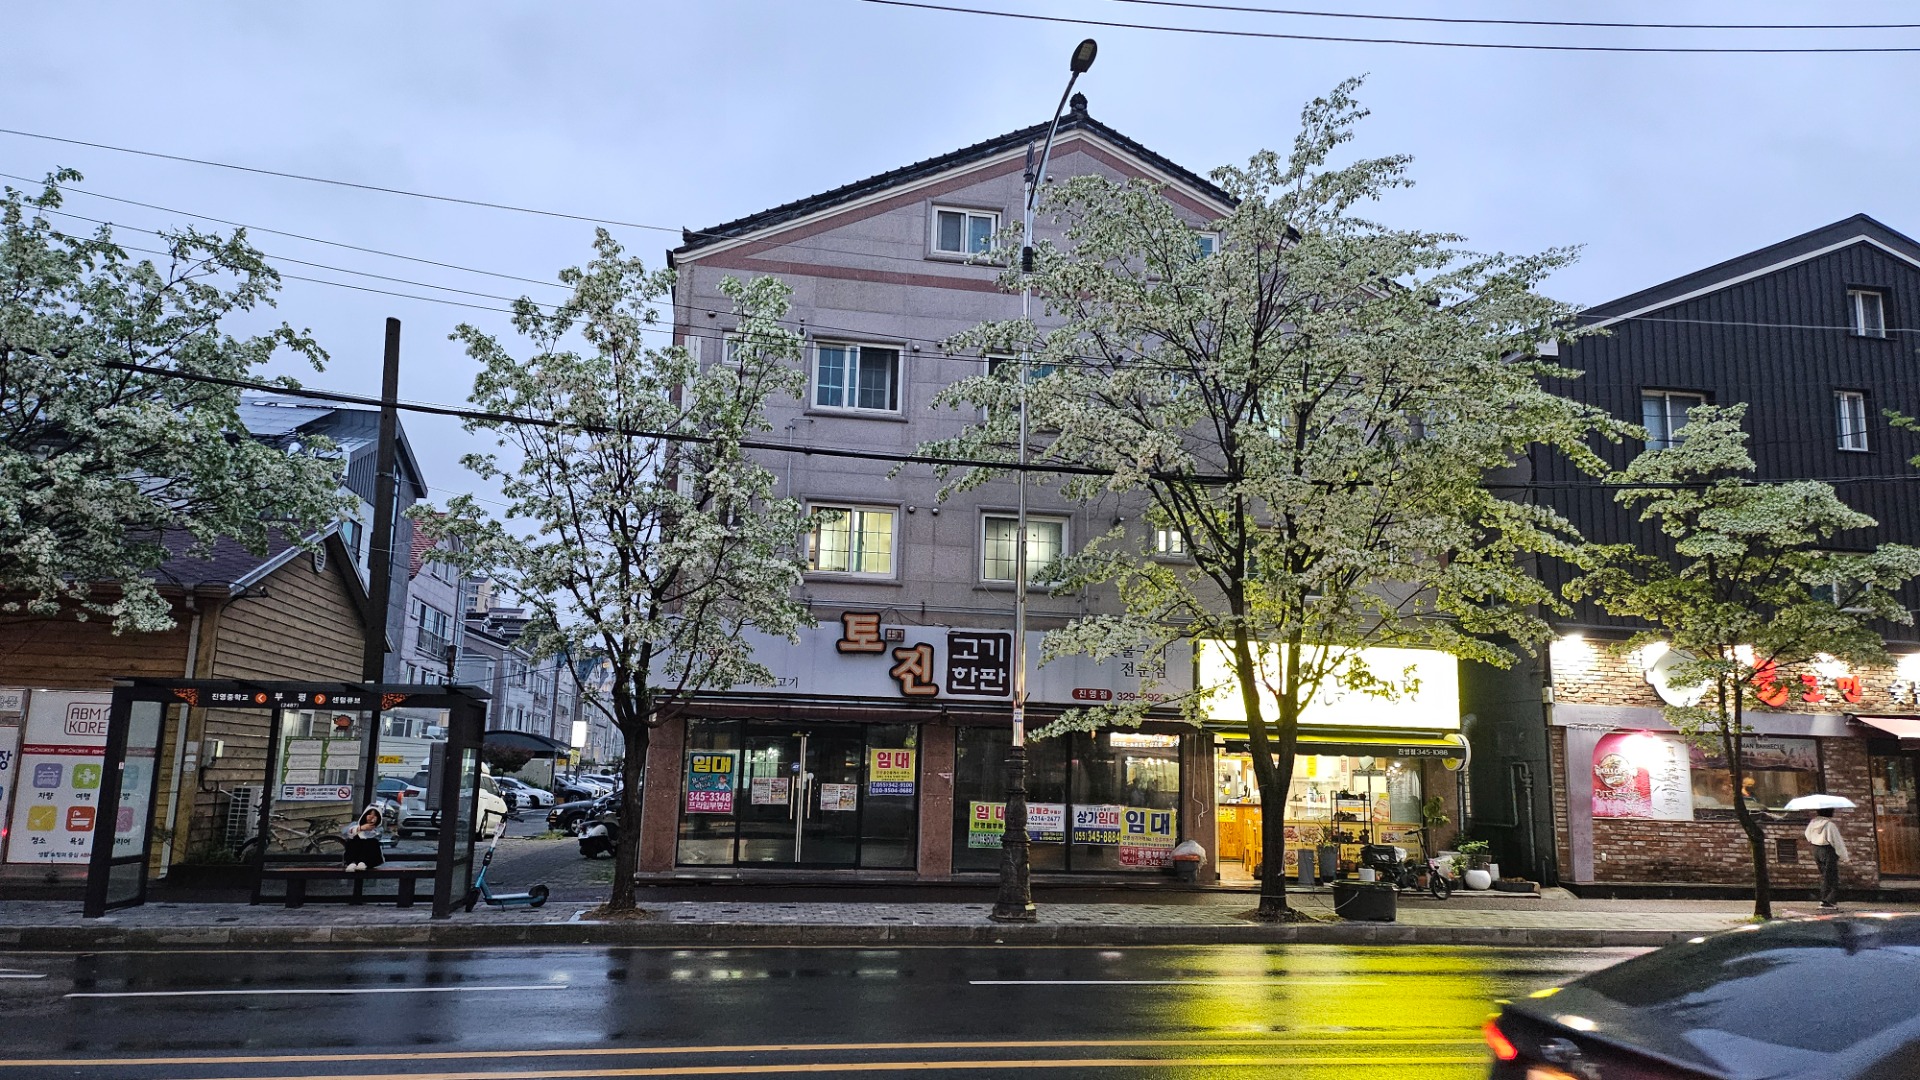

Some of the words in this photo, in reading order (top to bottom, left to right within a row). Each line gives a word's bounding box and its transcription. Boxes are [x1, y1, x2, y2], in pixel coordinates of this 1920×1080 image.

[952, 638, 1004, 662] 고기
[952, 667, 1006, 691] 한판
[211, 693, 249, 701] 진영중학교
[1078, 689, 1108, 699] 진영점
[70, 707, 101, 720] ABM
[68, 721, 107, 734] KORE
[692, 755, 731, 773] 임대
[876, 751, 910, 769] 임대
[38, 792, 54, 800] 차량
[689, 791, 731, 801] 345-3348
[1077, 811, 1119, 824] 상가임대
[1125, 810, 1170, 835] 임대
[31, 837, 47, 845] 청소
[70, 837, 85, 845] 욕실
[114, 837, 131, 845] 리어
